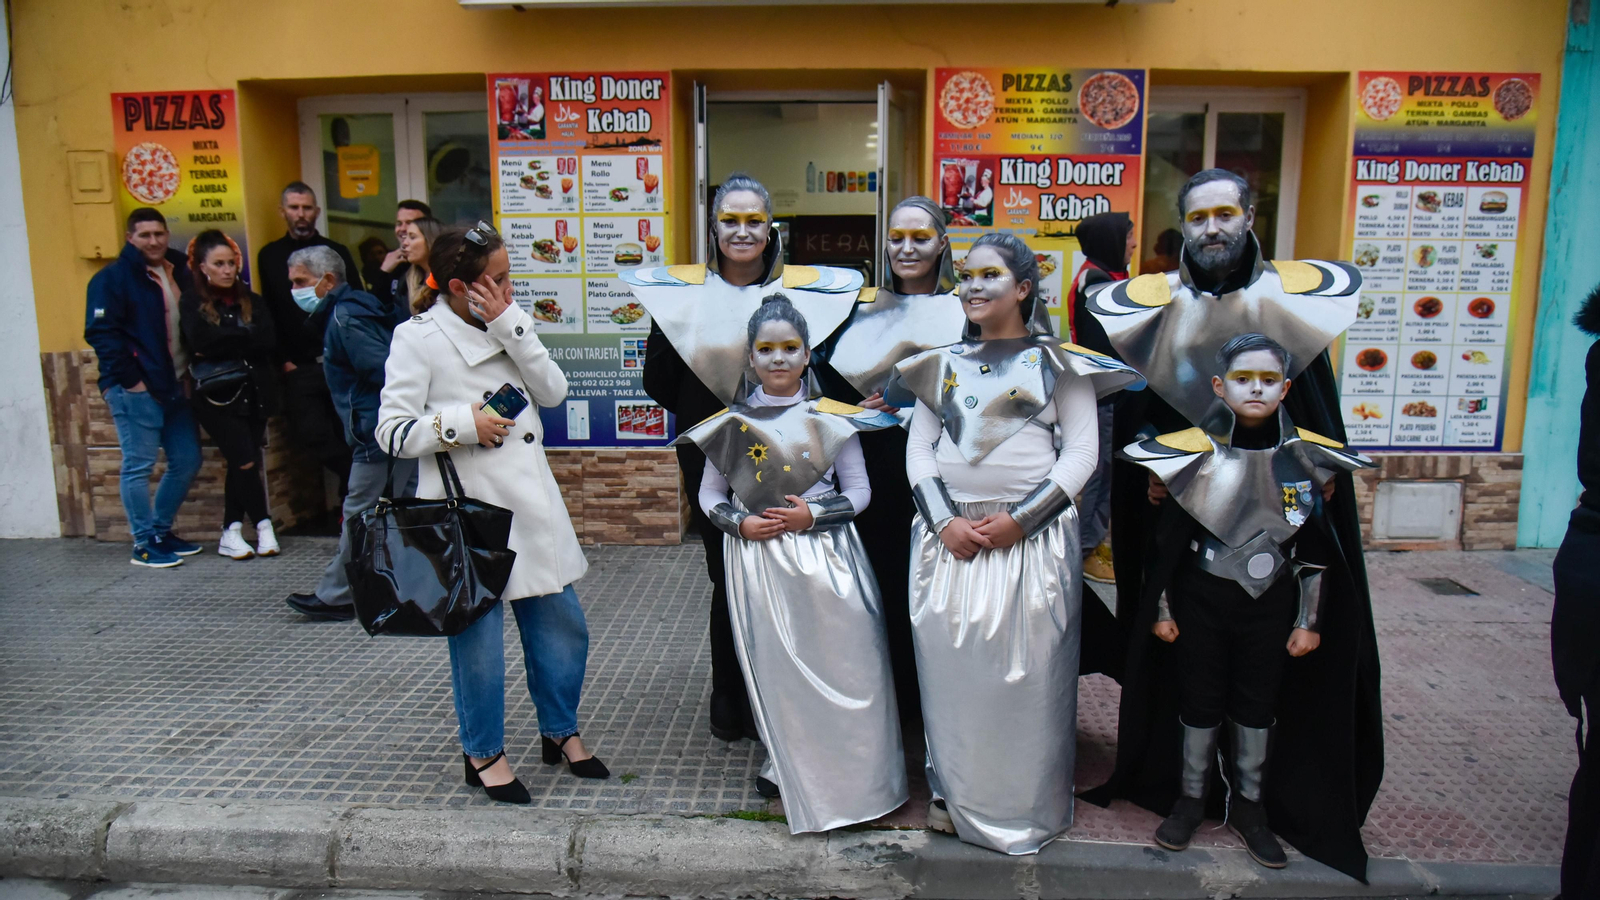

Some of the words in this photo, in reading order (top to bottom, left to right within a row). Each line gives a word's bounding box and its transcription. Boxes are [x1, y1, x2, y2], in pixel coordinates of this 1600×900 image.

[549, 76, 596, 103] King
[601, 76, 662, 100] Doner
[1002, 74, 1072, 92] PIZZAS
[1408, 76, 1490, 97] PIZZAS
[123, 94, 225, 132] PIZZAS
[587, 108, 651, 133] Kebab
[193, 140, 218, 150] MIXTA
[194, 155, 220, 164] POLLO
[190, 170, 228, 179] TERNERA
[1000, 158, 1050, 188] King
[1056, 159, 1125, 185] Doner
[1356, 160, 1400, 183] King
[1404, 161, 1462, 182] Doner
[1465, 161, 1525, 182] Kebab
[193, 184, 227, 194] GAMBAS
[1040, 194, 1110, 221] Kebab
[1443, 192, 1464, 208] KEBAB
[188, 213, 237, 222] MARGARITA
[806, 234, 870, 252] KEBA
[548, 348, 564, 360] GAR
[565, 348, 583, 360] CON
[585, 347, 619, 360] TARJETA
